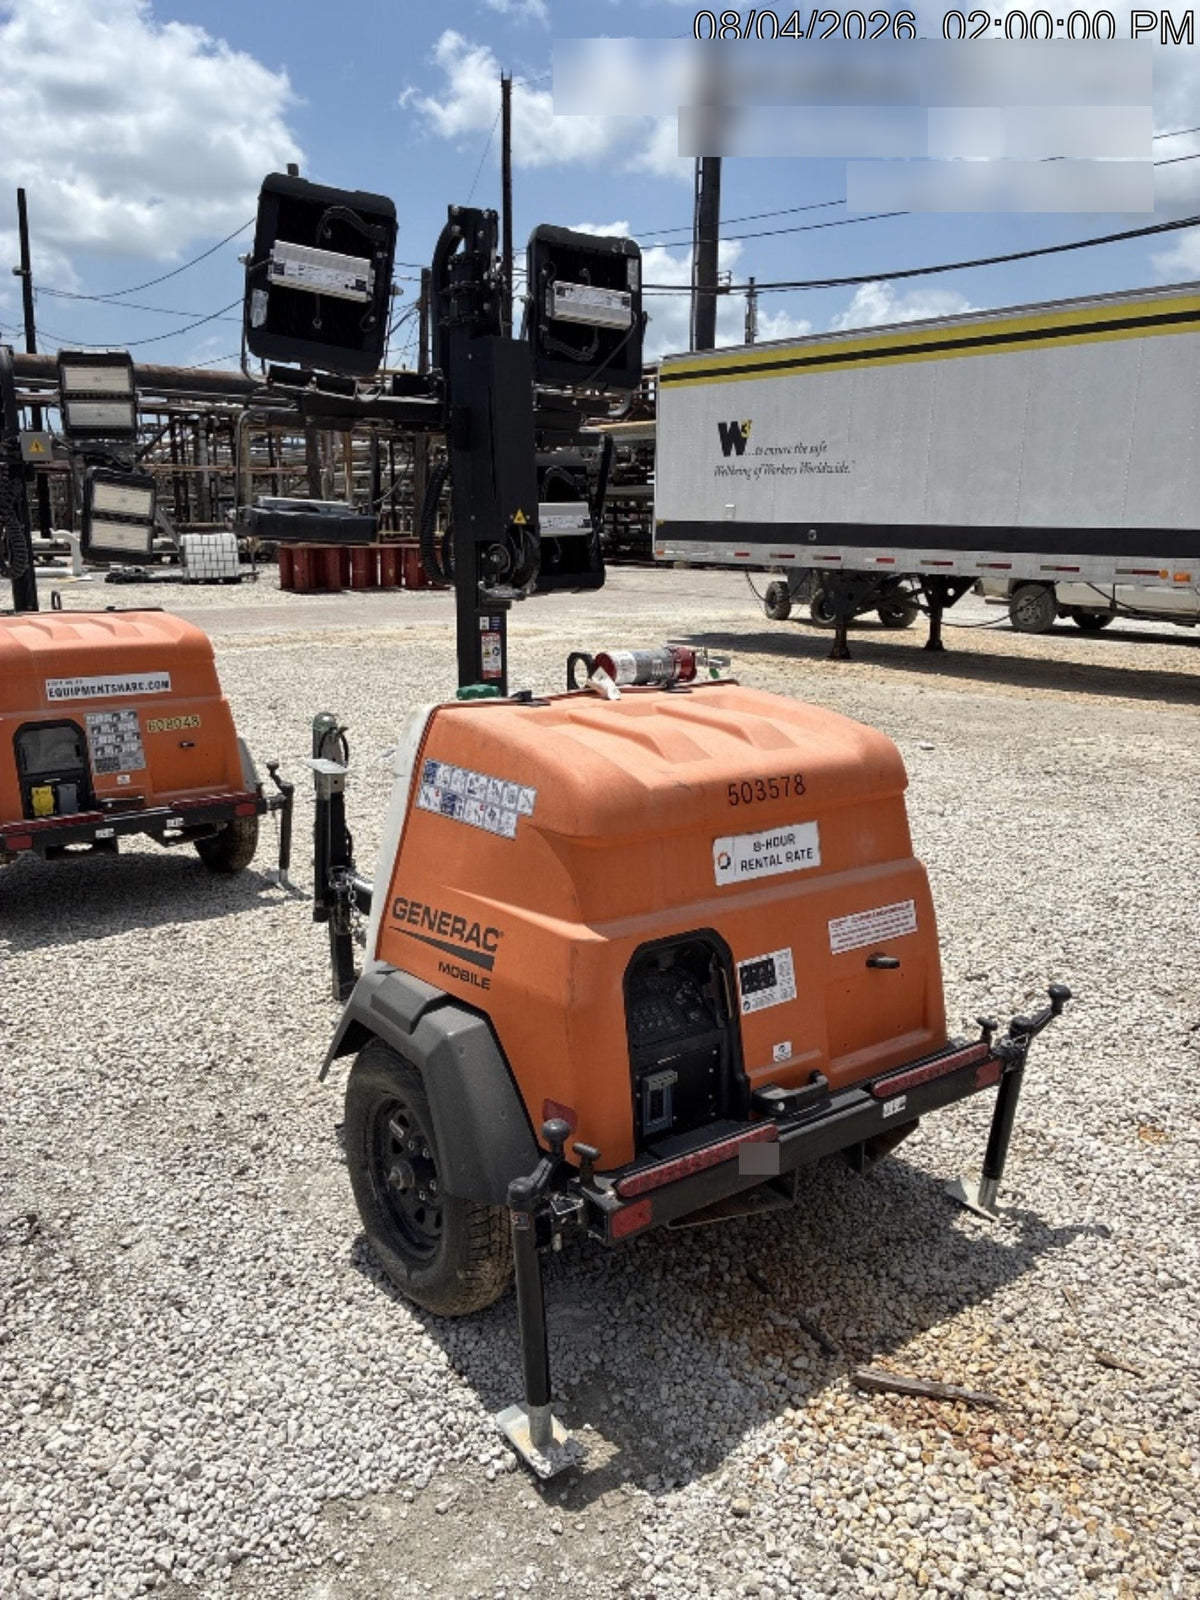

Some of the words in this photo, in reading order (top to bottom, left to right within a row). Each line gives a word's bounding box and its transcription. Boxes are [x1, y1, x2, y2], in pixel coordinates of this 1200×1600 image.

[794, 442, 807, 455] the
[809, 441, 828, 457] safe
[753, 465, 763, 480] of
[763, 463, 797, 476] Workers
[48, 680, 169, 697] EQUIPMENTSHARE.COM
[728, 773, 806, 807] 503578
[753, 833, 796, 853] 8-HOUR
[741, 855, 783, 872] RENTAL
[785, 847, 814, 864] RATE
[392, 897, 499, 952] GENERAC
[438, 961, 492, 991] MOBILE
